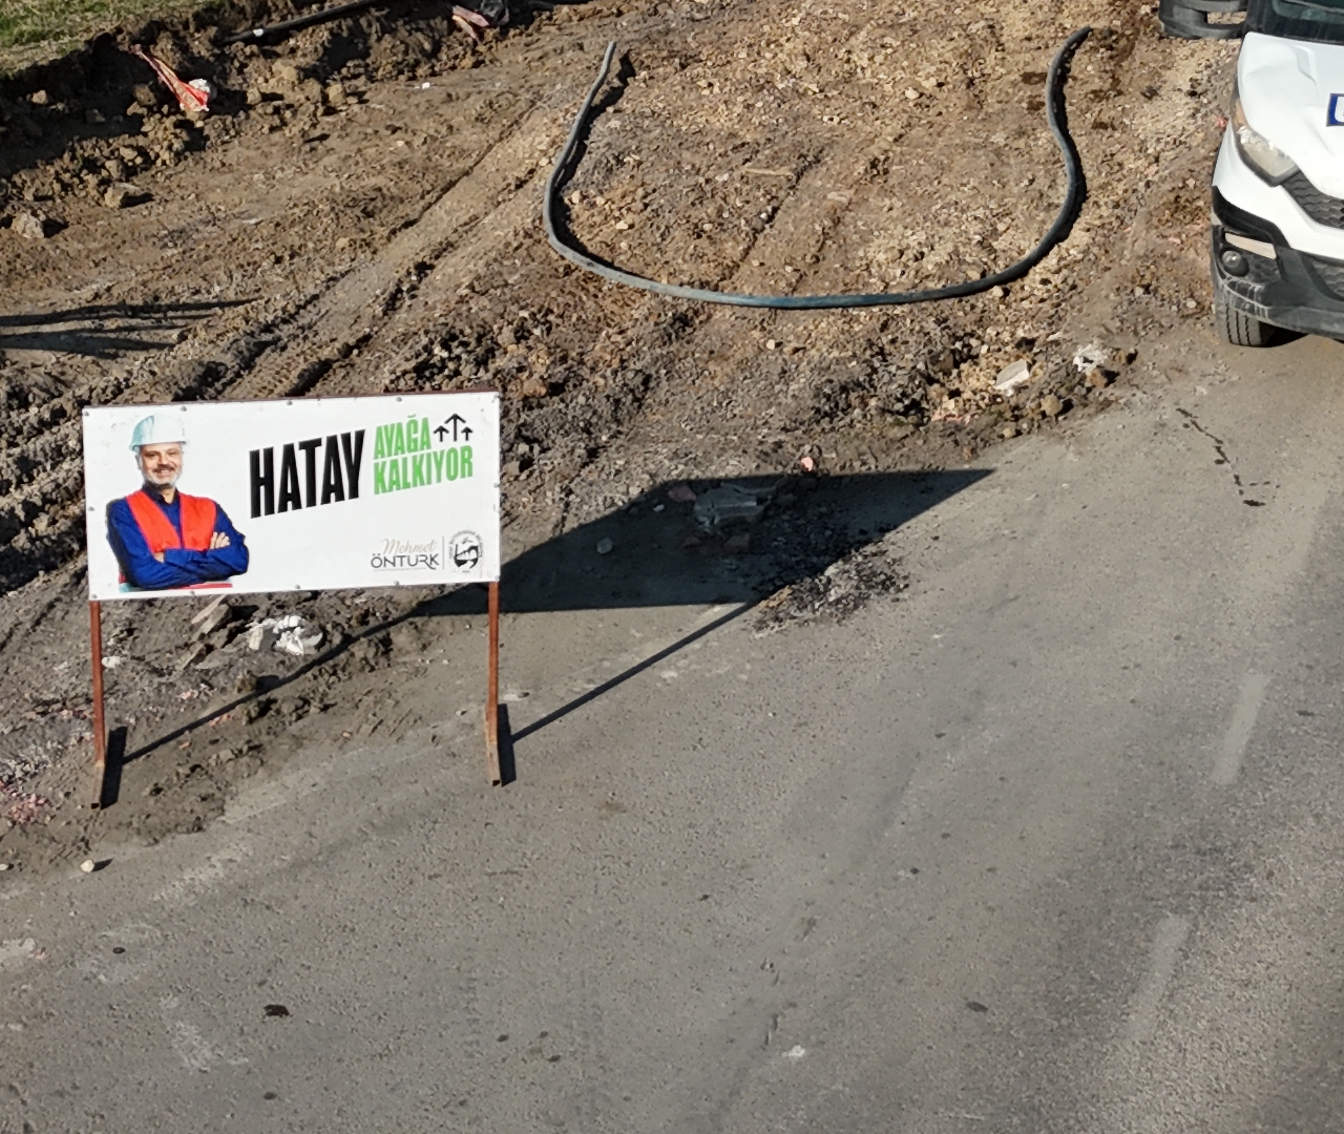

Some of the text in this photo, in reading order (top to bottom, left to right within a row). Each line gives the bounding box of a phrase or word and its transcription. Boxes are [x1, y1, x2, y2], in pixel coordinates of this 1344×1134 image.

[373, 414, 432, 460] AYAĞA
[249, 429, 366, 519] HATAY
[373, 444, 474, 495] KALKIYOR
[381, 537, 438, 554] Mehmet
